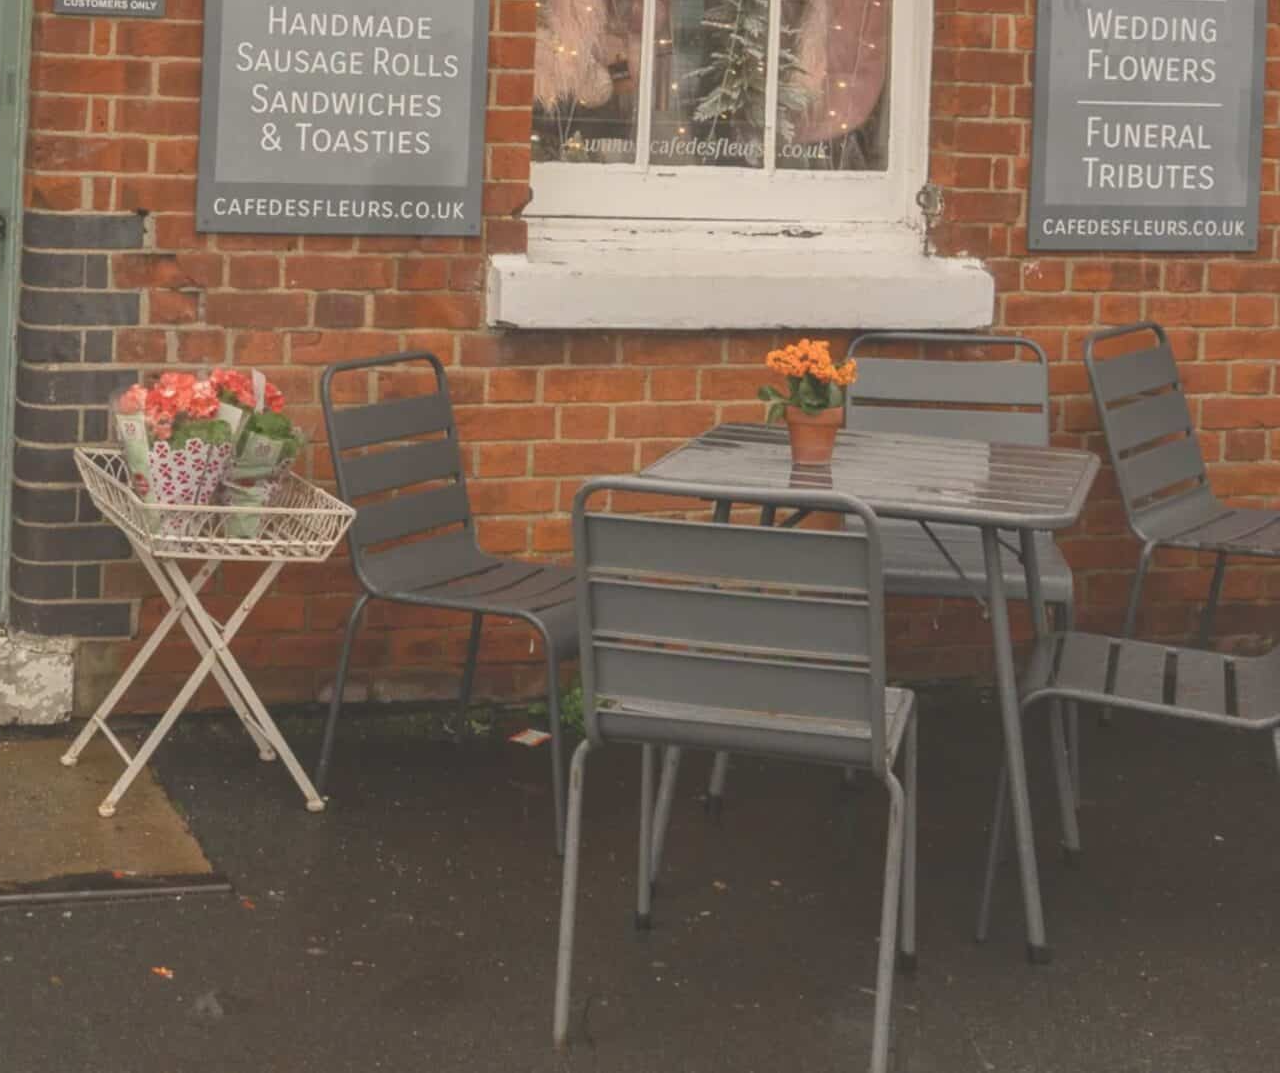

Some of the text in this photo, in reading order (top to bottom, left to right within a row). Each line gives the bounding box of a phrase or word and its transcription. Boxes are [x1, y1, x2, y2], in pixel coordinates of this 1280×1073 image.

[130, 0, 158, 10] ONLY
[269, 6, 432, 40] HANDMADE
[1086, 8, 1217, 43] WEDDING
[236, 42, 458, 78] SAUSAGE ROLLS
[1087, 49, 1216, 83] FLOWERS
[251, 84, 441, 118] SANDWICHES
[260, 122, 431, 155] & TOASTIES
[1086, 116, 1211, 149] FUNERAL
[1082, 157, 1215, 191] TRIBUTES
[213, 196, 465, 220] CAFEDESFLEURS.CO.UK
[1042, 218, 1245, 238] CAFEDESFLEURS.CO.UK
